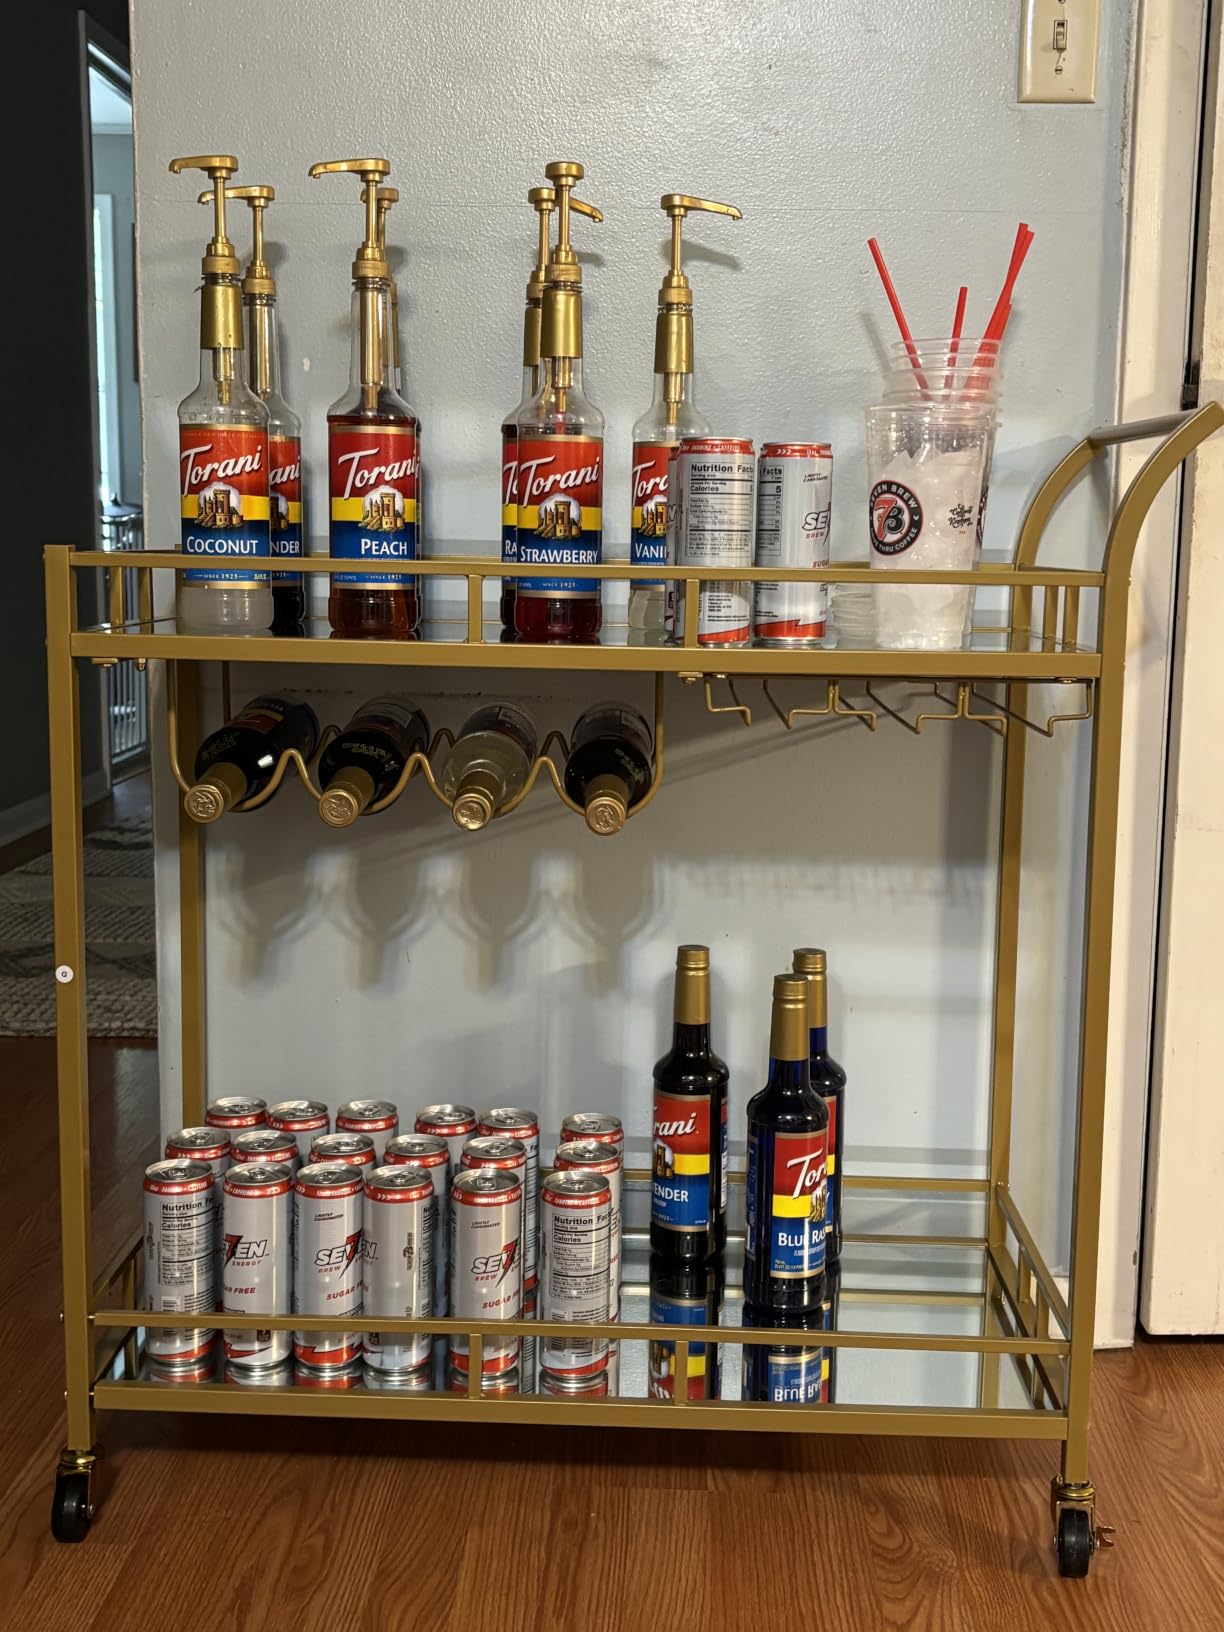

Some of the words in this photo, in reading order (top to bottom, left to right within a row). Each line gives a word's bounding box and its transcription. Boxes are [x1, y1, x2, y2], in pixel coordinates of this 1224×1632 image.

[180, 443, 262, 497] Torani
[337, 447, 416, 501] Torani
[691, 463, 733, 473] Nutrition
[519, 455, 599, 508] Torani
[775, 485, 782, 494] 5
[891, 484, 918, 508] BREW
[186, 536, 258, 555] COCONUT
[894, 527, 918, 551] COFFEE
[360, 538, 408, 556] PEACH
[520, 546, 599, 564] STRAWBERRY
[161, 1201, 203, 1212] Nutrition
[161, 1221, 192, 1229] Calories
[554, 1215, 594, 1225] Nutrition
[553, 1234, 582, 1243] Calories
[318, 1264, 341, 1274] BREW
[474, 1273, 498, 1281] BREW
[326, 1285, 356, 1301] SUGAR
[482, 1294, 512, 1309] SUGAR
